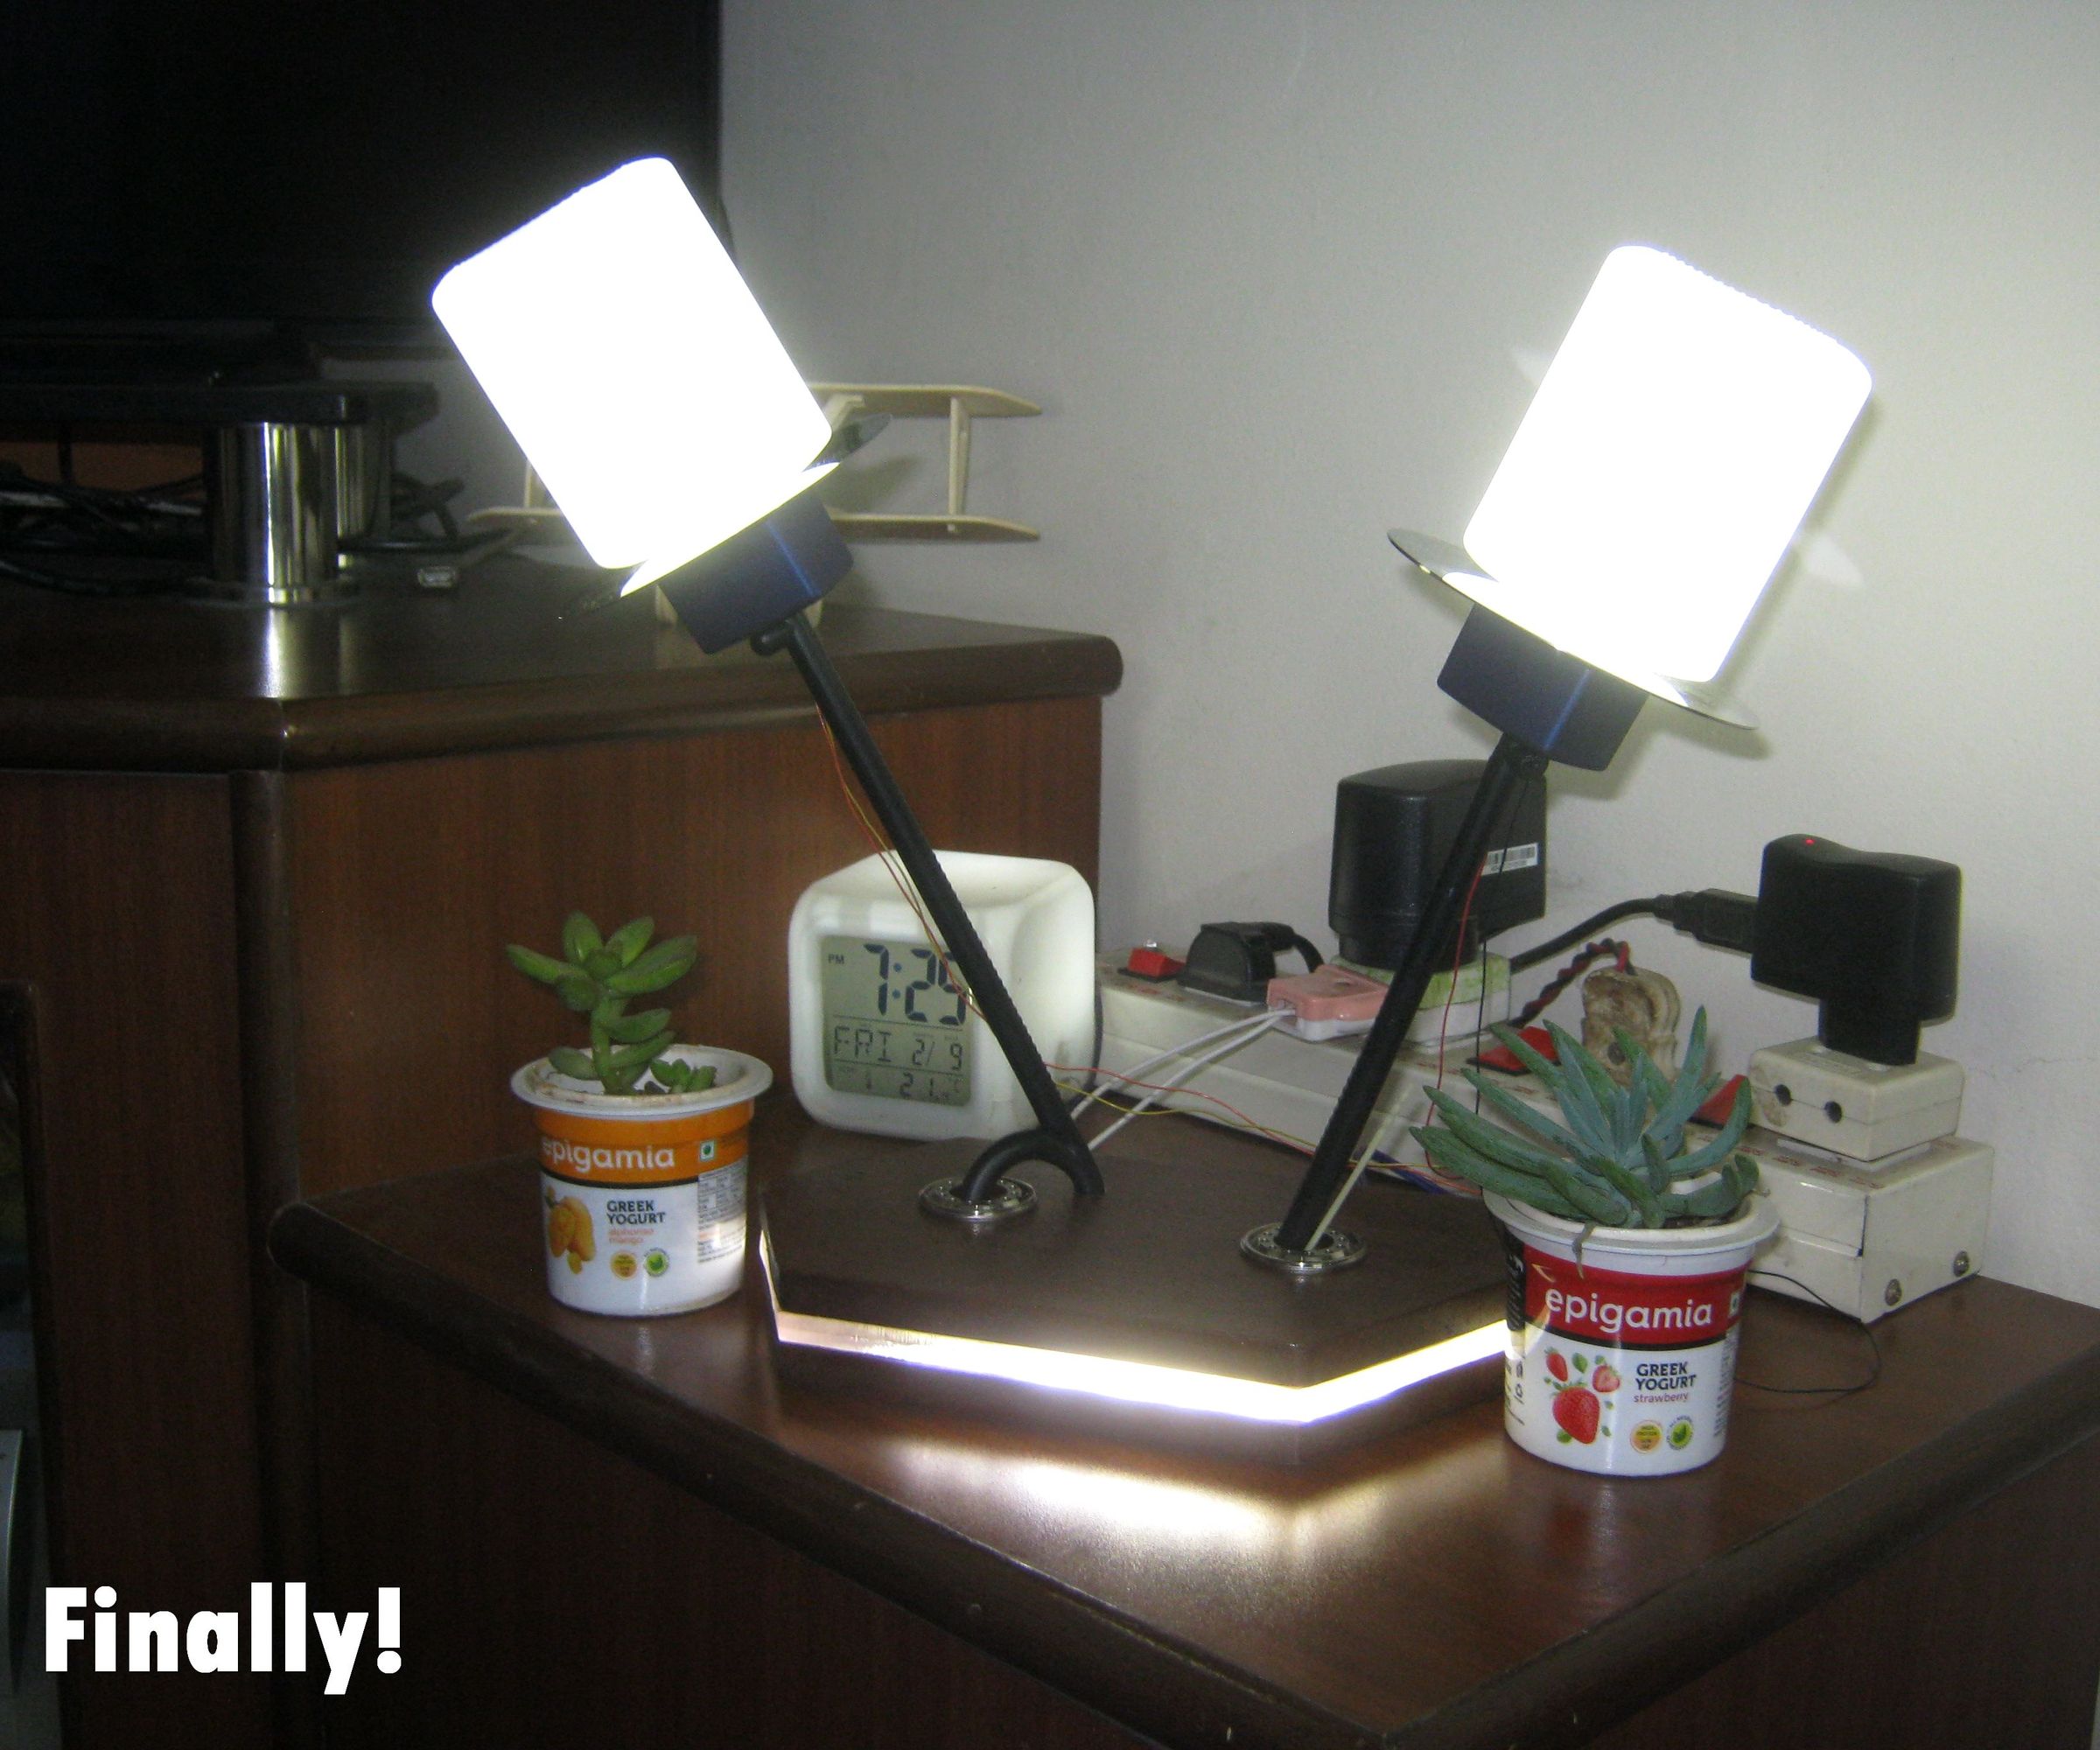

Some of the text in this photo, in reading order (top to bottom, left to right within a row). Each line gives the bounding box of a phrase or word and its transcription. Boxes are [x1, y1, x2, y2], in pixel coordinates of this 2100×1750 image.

[828, 953, 845, 964] PM
[834, 1026, 892, 1062] FRI
[606, 1200, 654, 1212] GREEK
[606, 1212, 666, 1225] YOGURT
[1545, 1288, 1712, 1334] epigamia
[1636, 1362, 1688, 1376] GREEK
[1635, 1375, 1697, 1390] YOGURT
[1634, 1393, 1689, 1403] strawberry
